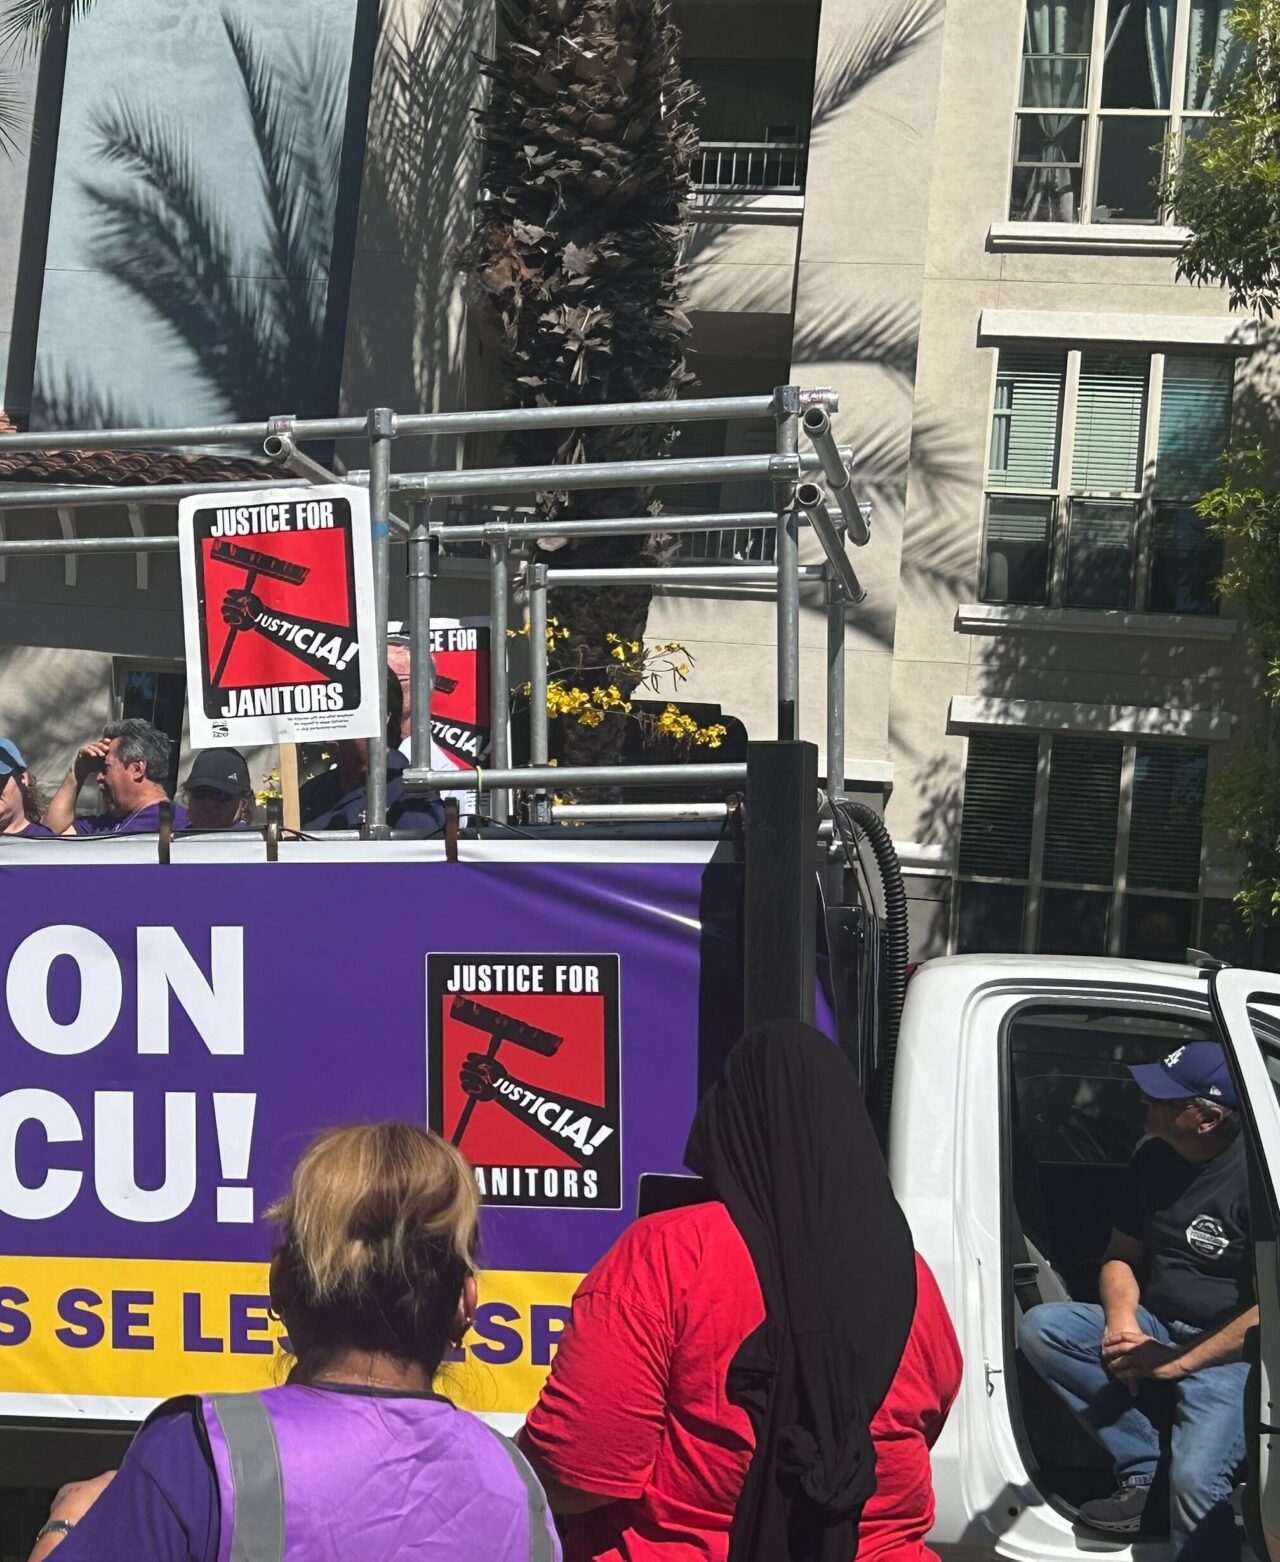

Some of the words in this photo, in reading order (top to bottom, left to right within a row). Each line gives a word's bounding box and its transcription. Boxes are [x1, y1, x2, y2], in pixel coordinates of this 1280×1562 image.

[210, 503, 291, 538] JUSTICE
[296, 501, 334, 530] FOR
[254, 612, 360, 671] JUSTICIA!
[447, 629, 477, 652] FOR
[220, 682, 344, 718] JANITORS
[5, 924, 245, 1056] ON
[447, 964, 544, 993] JUSTICE
[555, 965, 600, 993] FOR
[492, 1077, 614, 1156] JUSTICIA!
[475, 1167, 599, 1199] ANITORS
[55, 1288, 155, 1351] SE
